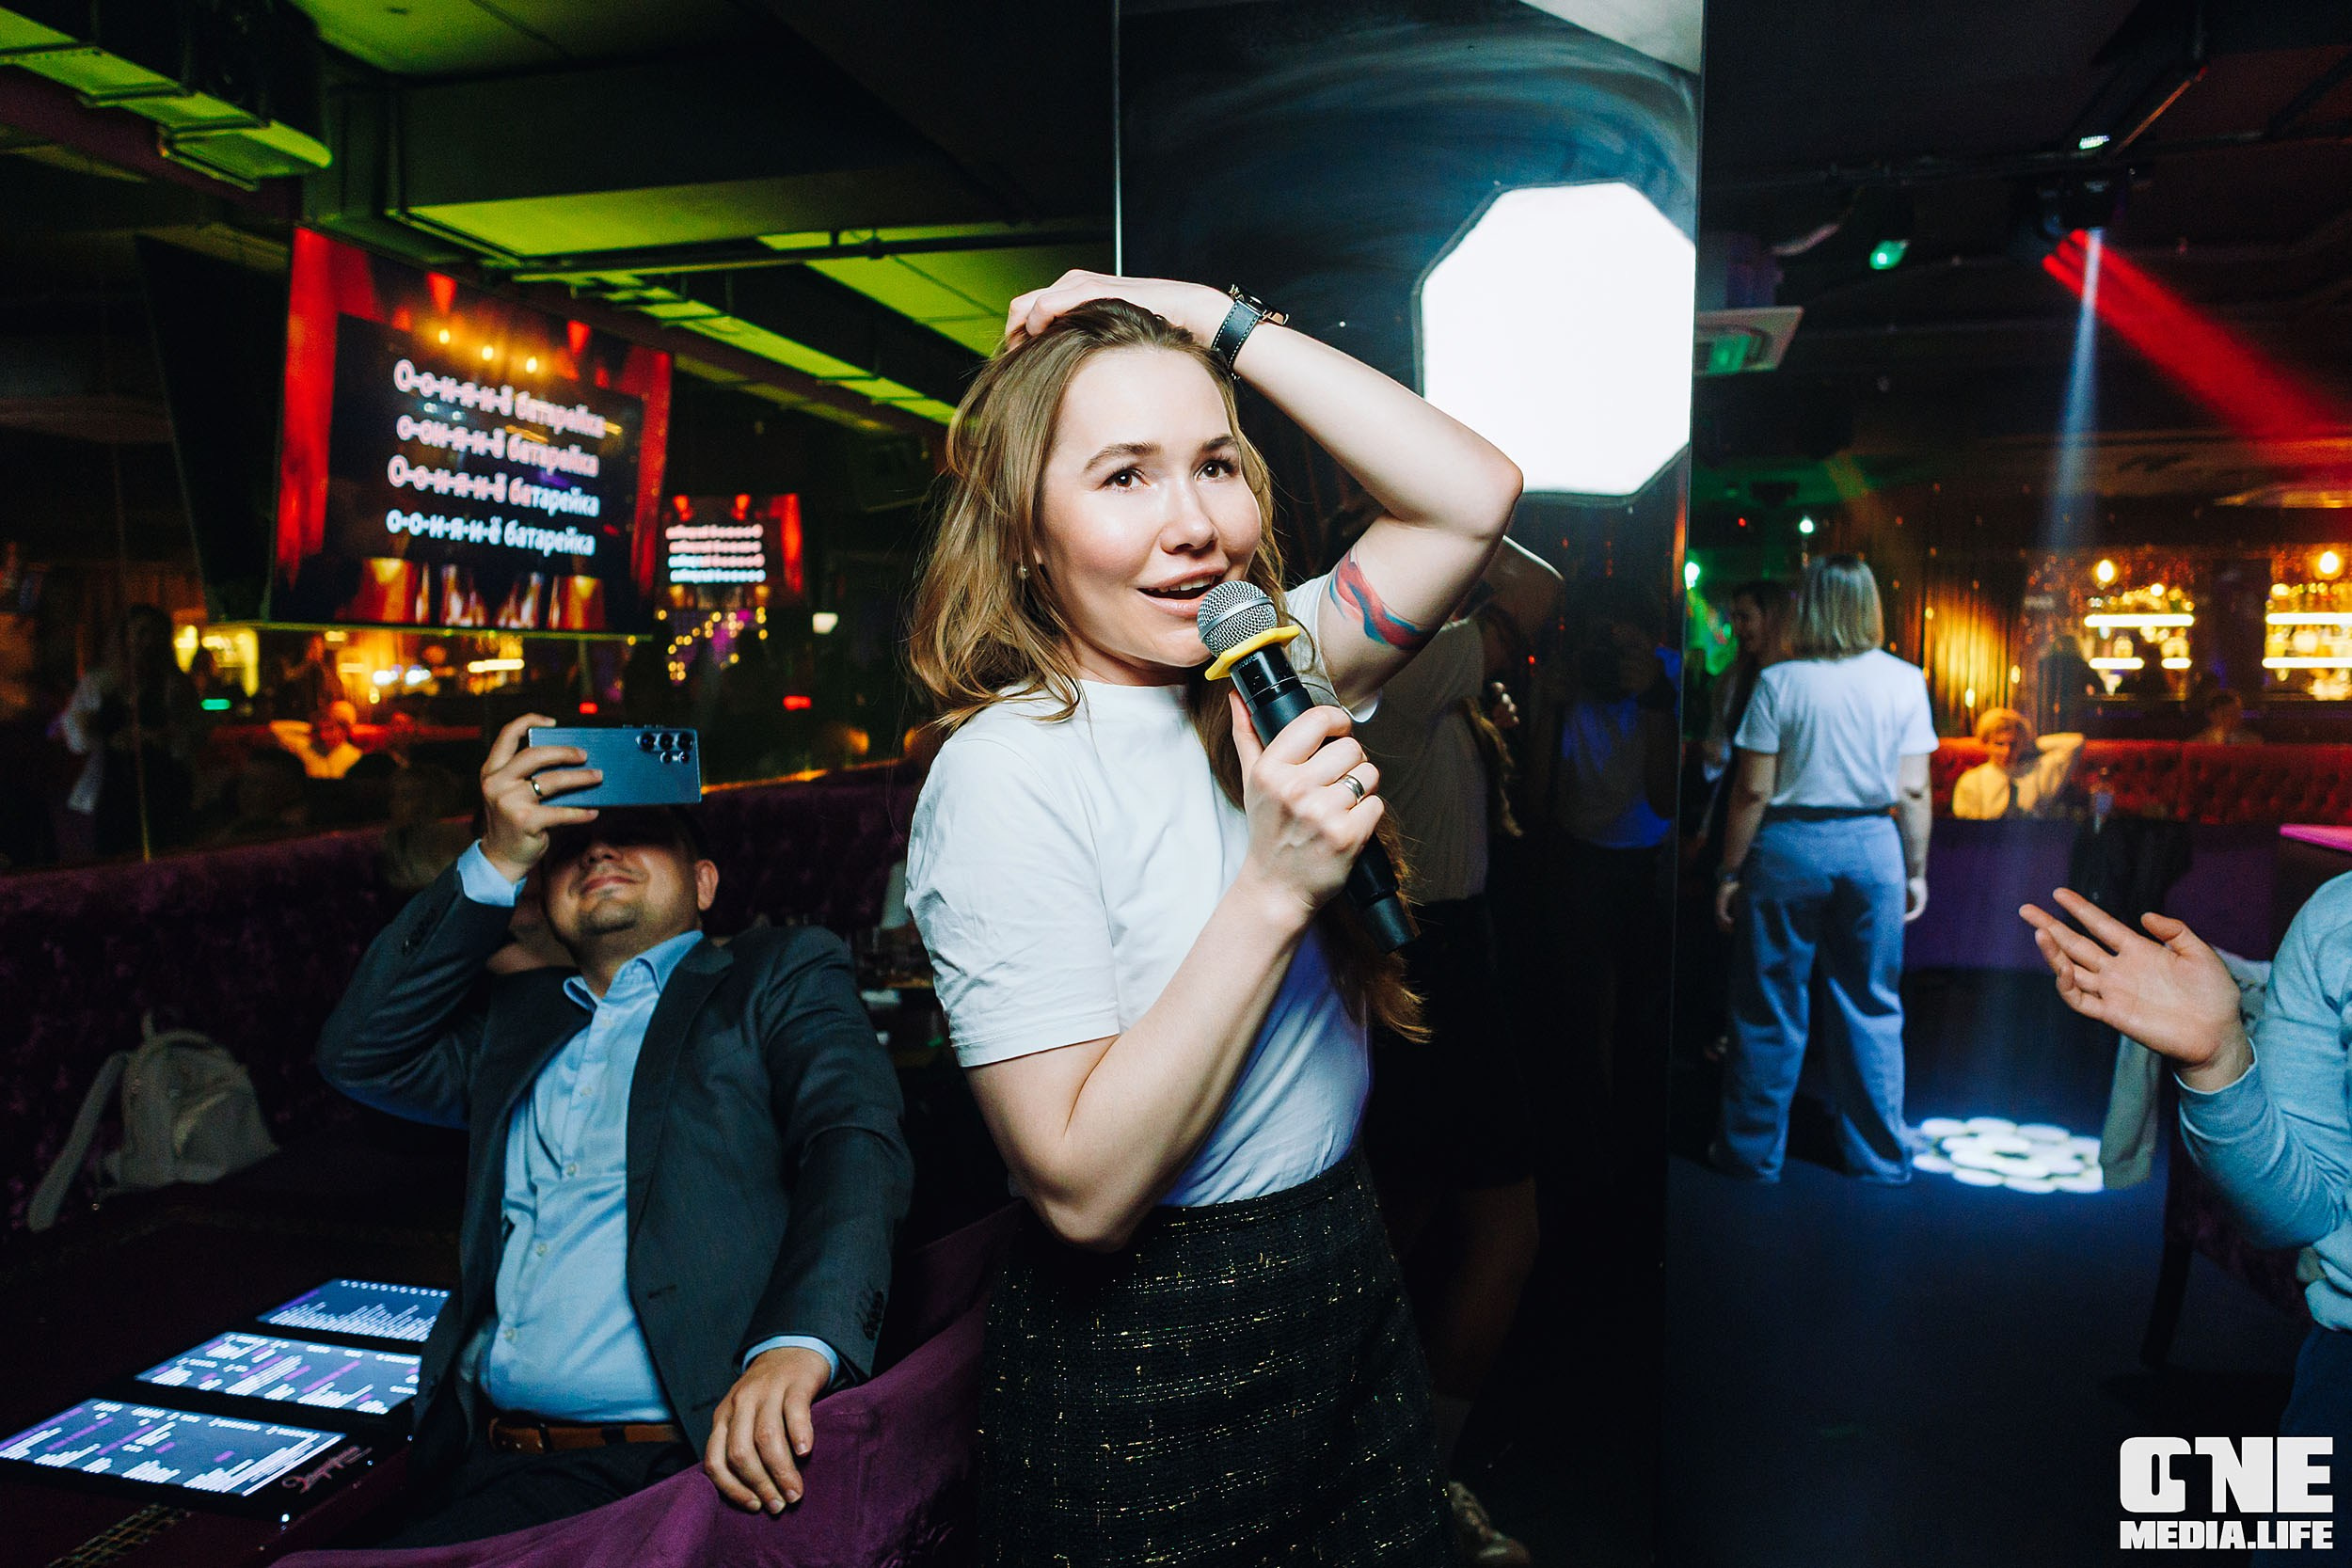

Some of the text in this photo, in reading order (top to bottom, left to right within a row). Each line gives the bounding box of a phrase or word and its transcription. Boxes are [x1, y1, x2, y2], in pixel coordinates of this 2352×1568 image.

[515, 391, 606, 438] батарейка
[507, 434, 599, 477] батарейка
[508, 477, 600, 516] батарейка
[504, 519, 596, 557] батарейка
